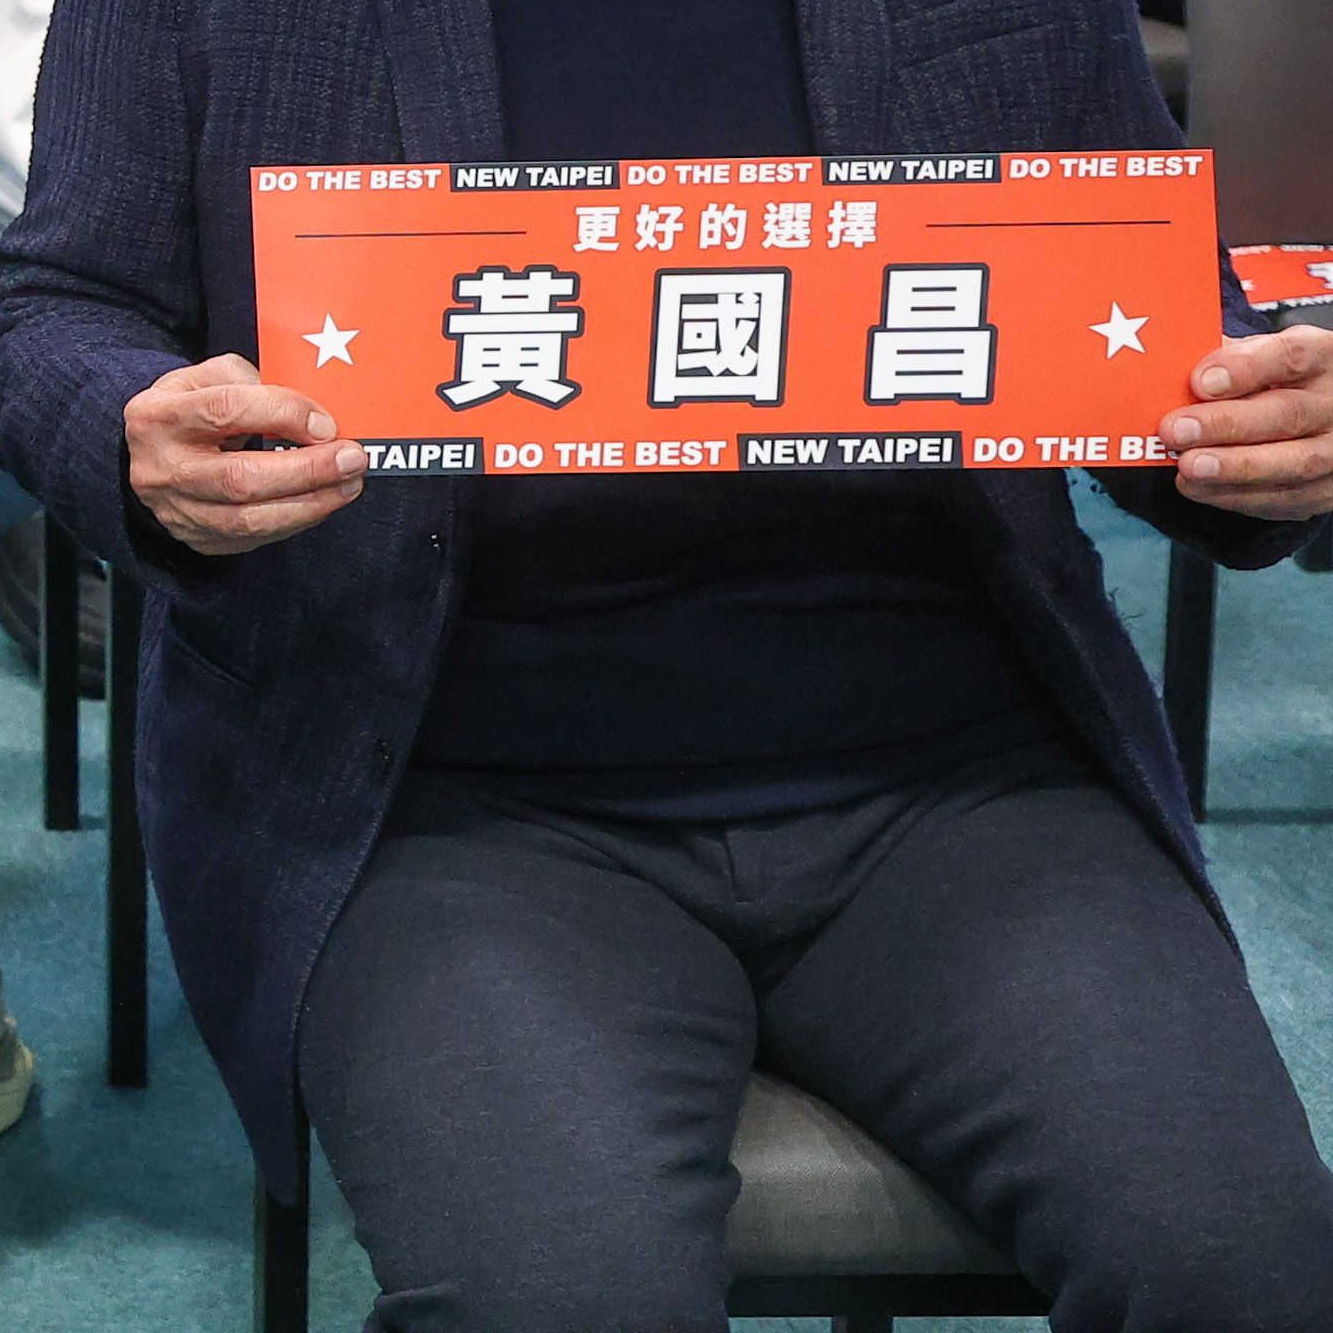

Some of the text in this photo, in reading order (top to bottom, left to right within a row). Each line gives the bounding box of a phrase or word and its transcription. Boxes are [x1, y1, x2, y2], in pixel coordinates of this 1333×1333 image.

[258, 156, 1203, 192] DO THE BEST NEW TAIPEI DO THE BEST NEW TAIPEI DO THE BEST
[572, 200, 878, 252] 更好的選擇
[438, 267, 994, 408] 黃國昌
[363, 436, 1109, 470] TAIPEI DO THE BEST NEW TAIPEI DO THE
